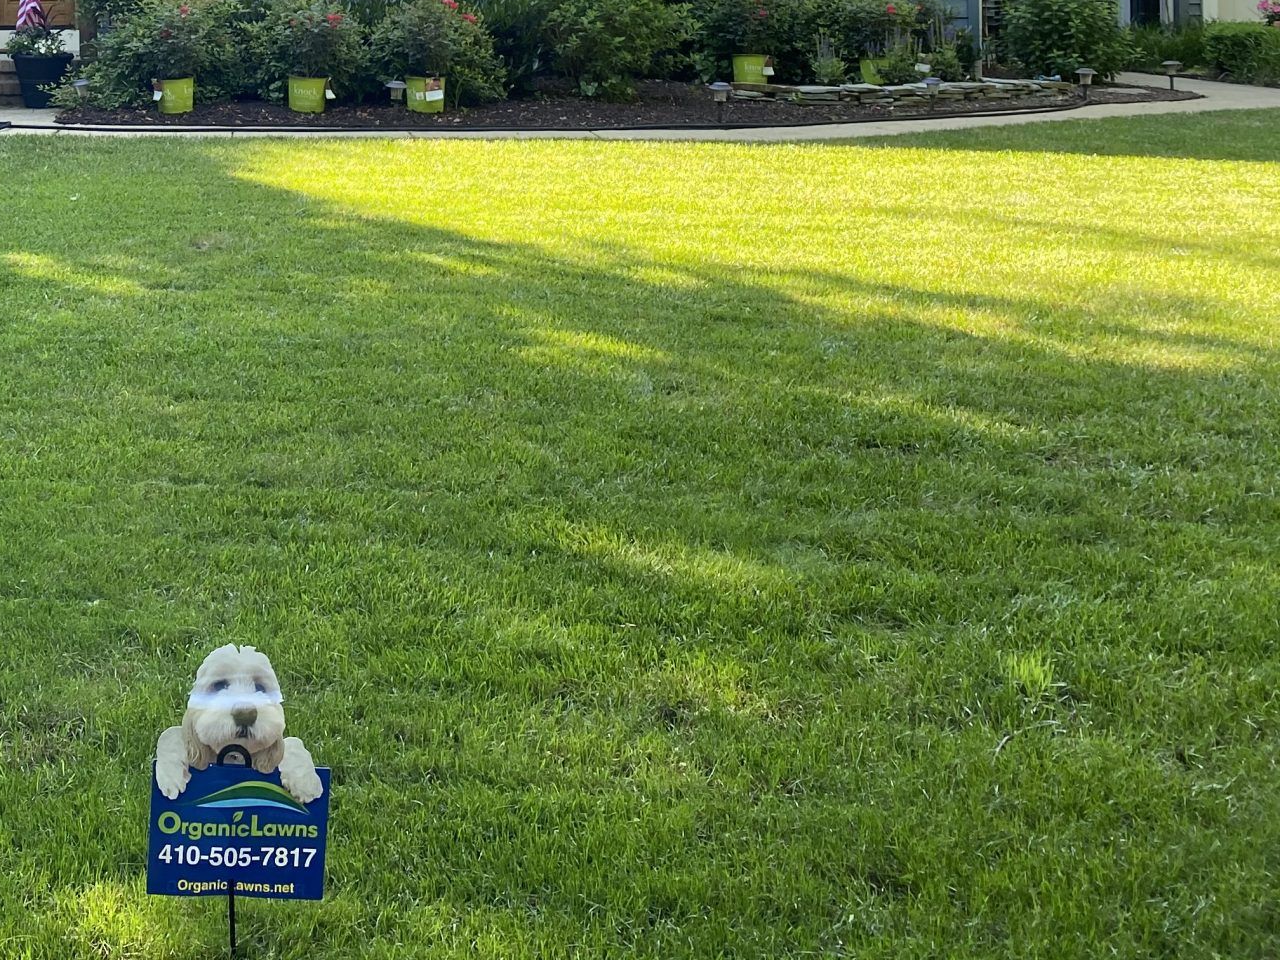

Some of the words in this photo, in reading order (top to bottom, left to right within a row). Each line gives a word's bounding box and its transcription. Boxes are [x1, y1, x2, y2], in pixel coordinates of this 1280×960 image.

[158, 811, 318, 840] OrganicLawns
[158, 844, 317, 868] 410-505-7817
[177, 879, 294, 893] Organicawns.net
